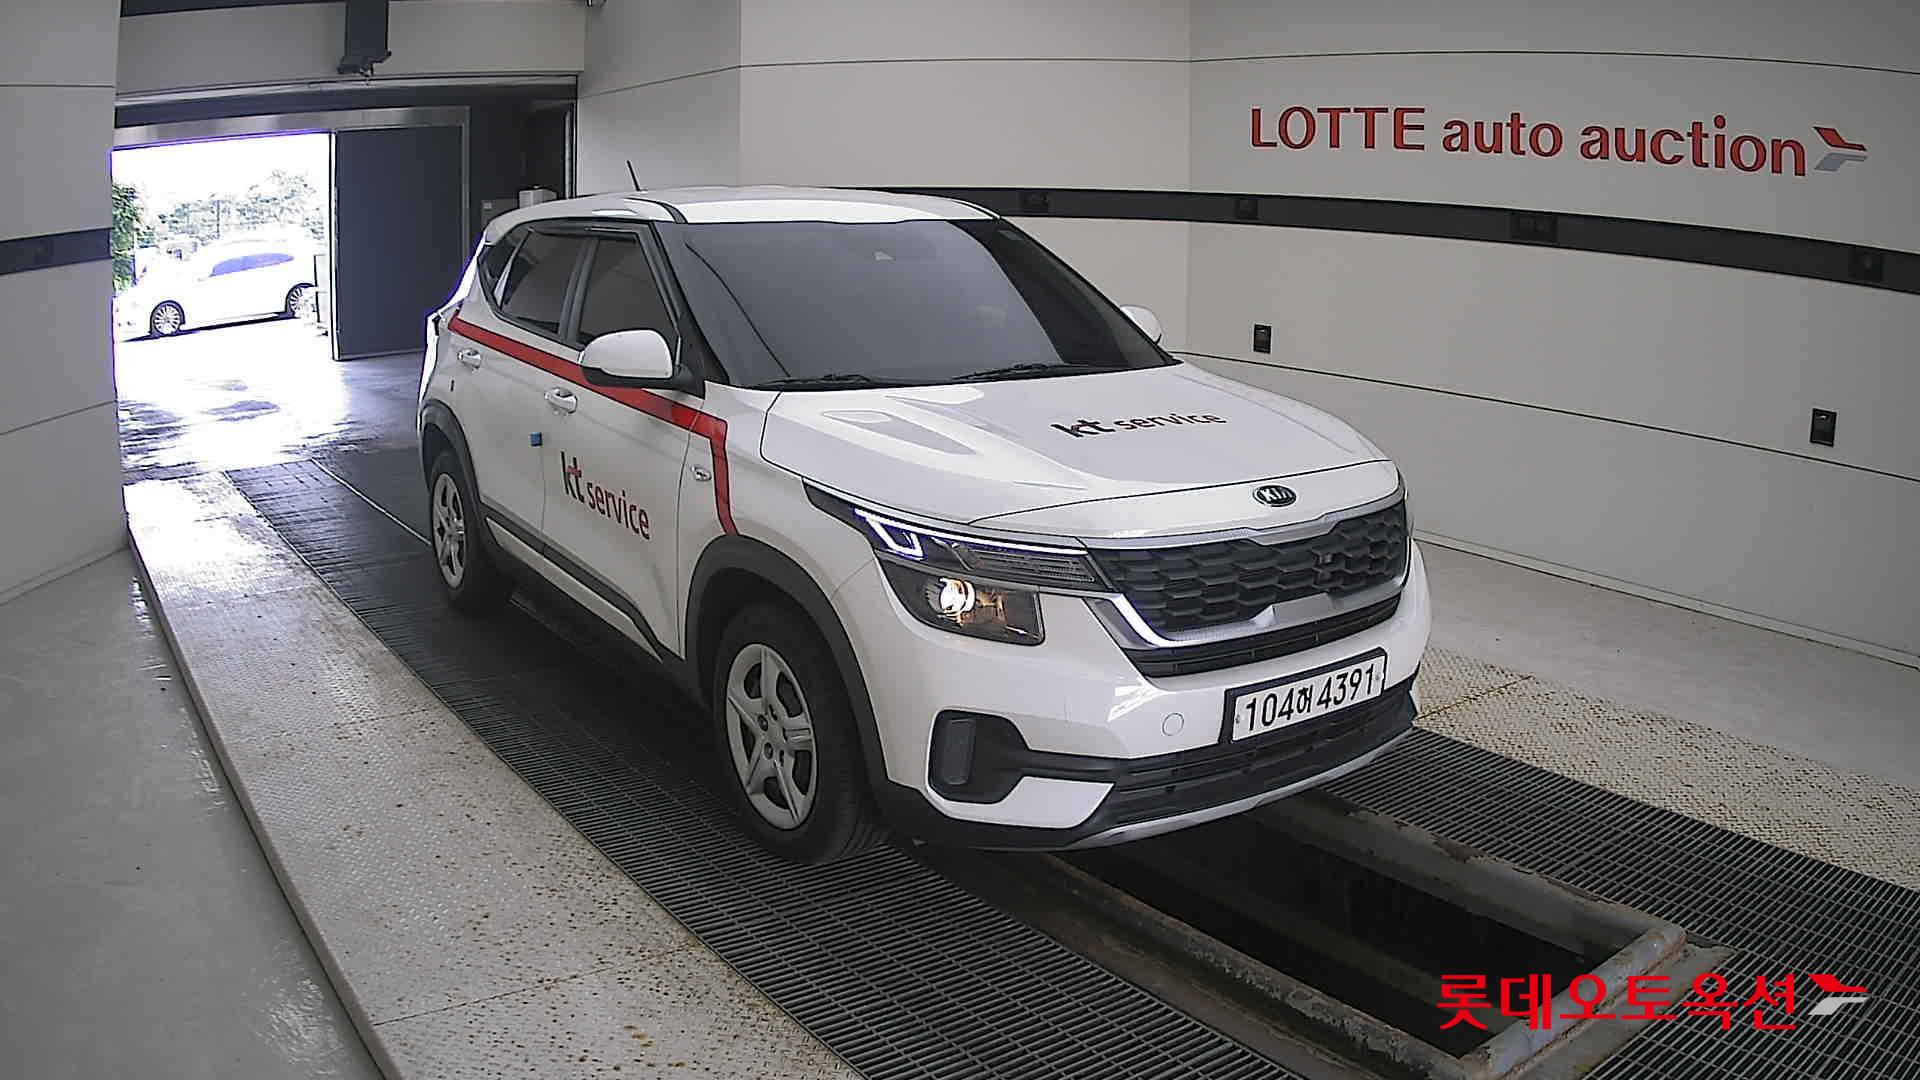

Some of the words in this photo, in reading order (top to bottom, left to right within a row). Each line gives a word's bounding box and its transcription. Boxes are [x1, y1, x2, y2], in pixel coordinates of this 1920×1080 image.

[1251, 106, 1426, 151] LOTTE
[1442, 112, 1563, 159] auto
[1579, 114, 1807, 177] auction
[1050, 419, 1116, 438] kt
[1113, 413, 1228, 431] service
[560, 450, 585, 504] kt
[586, 482, 651, 541] service
